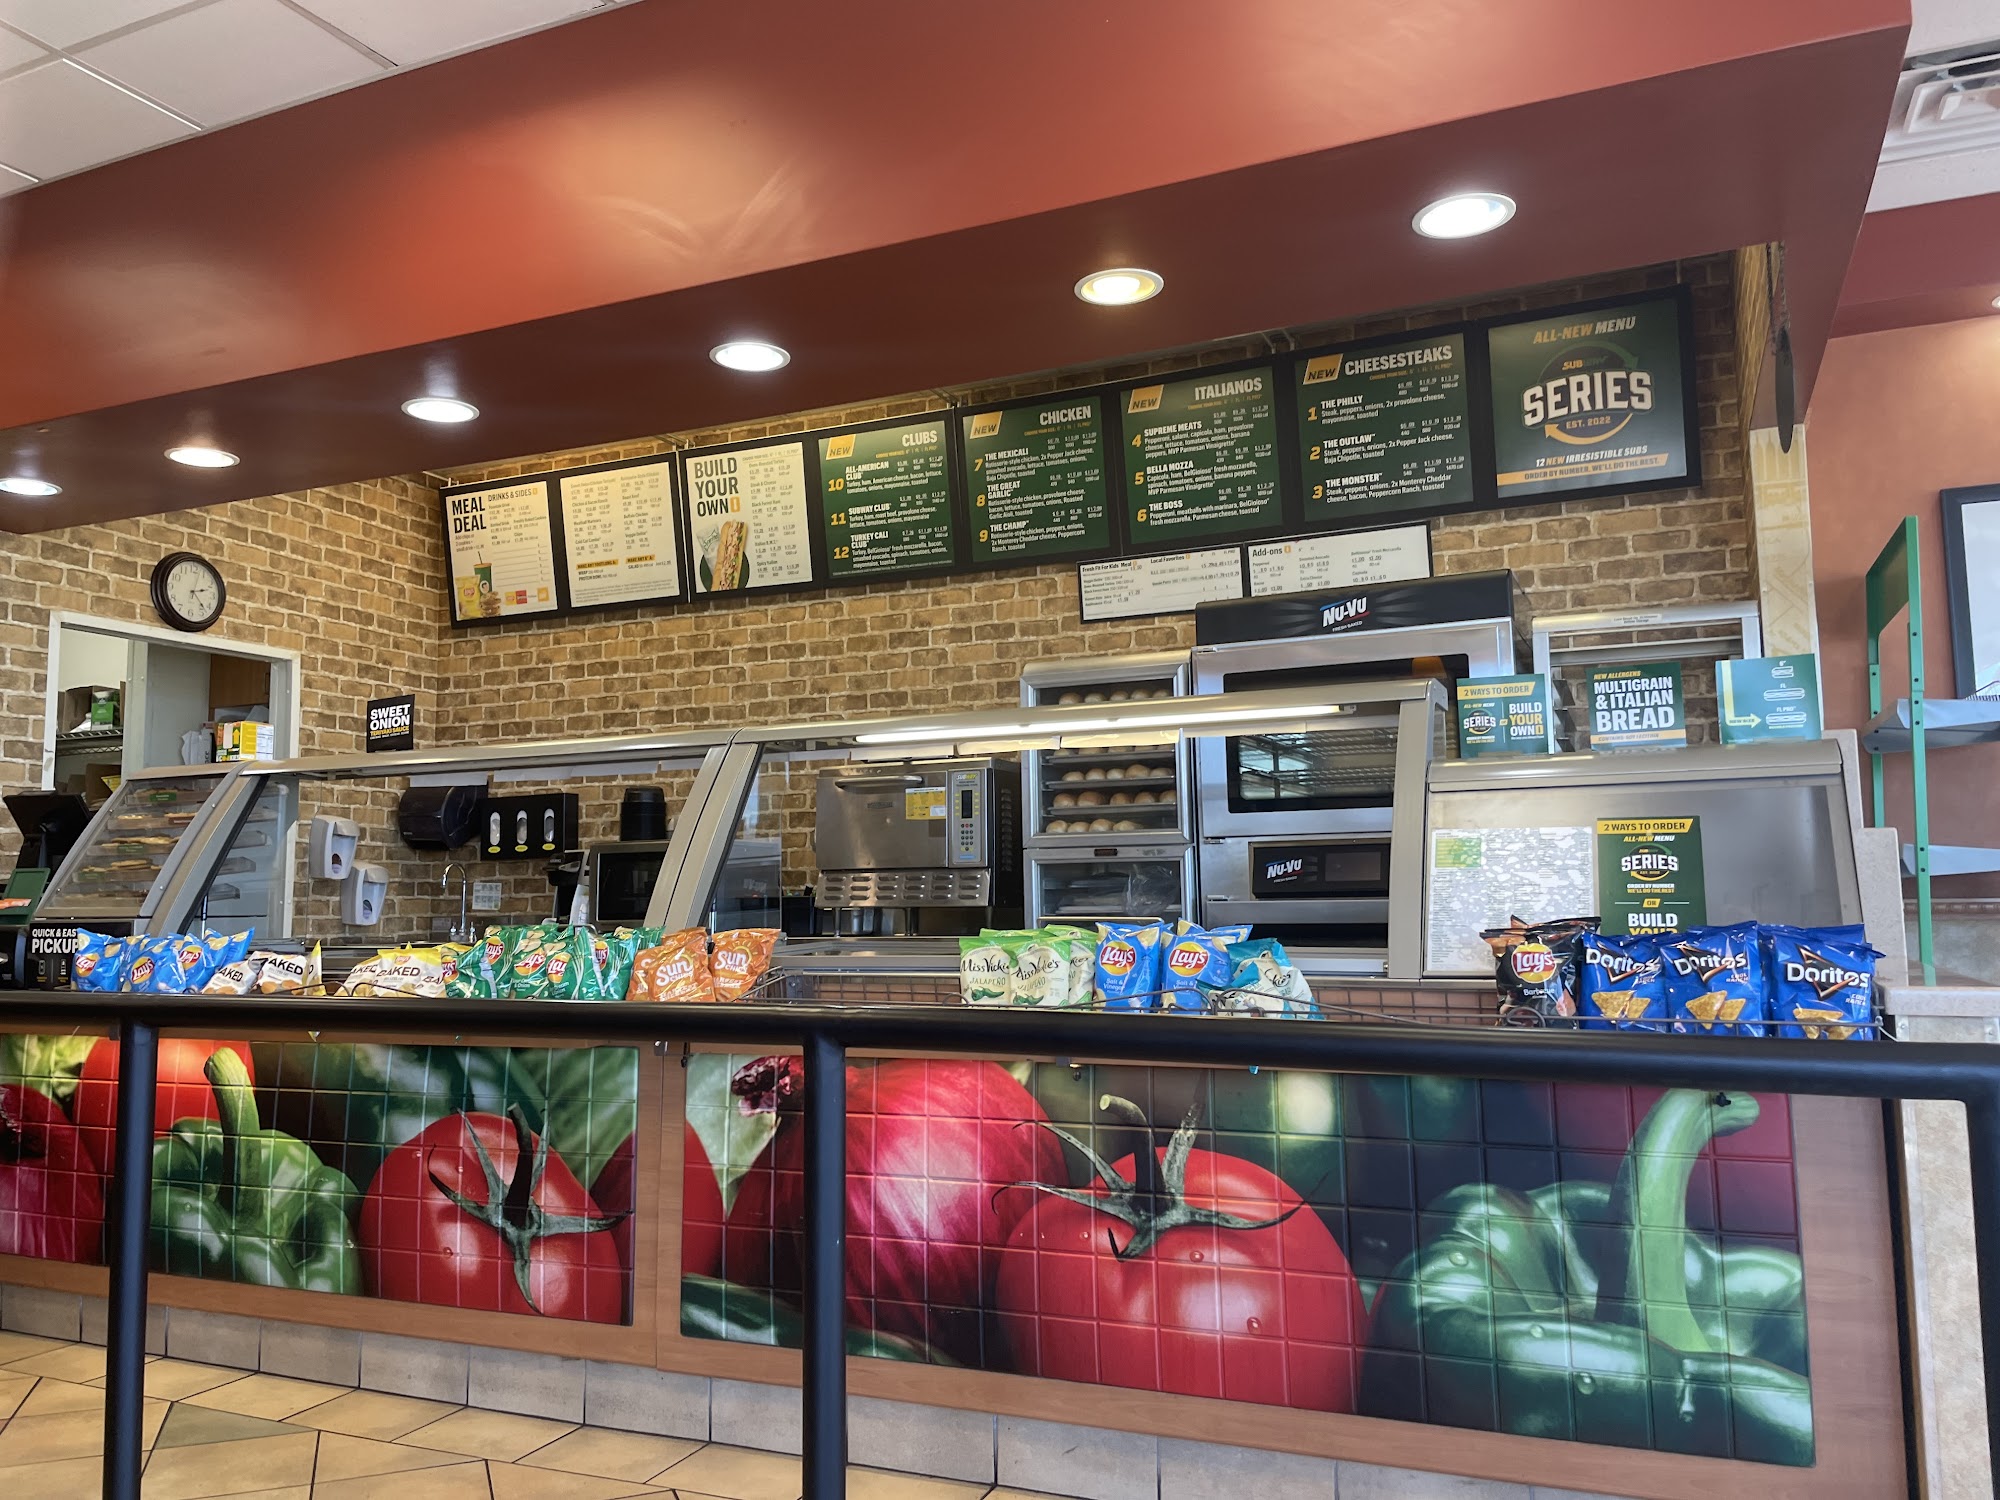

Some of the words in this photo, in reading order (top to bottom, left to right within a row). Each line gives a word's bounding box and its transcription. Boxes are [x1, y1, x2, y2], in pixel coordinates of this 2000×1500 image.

[1533, 322, 1593, 344] ALL-NEW
[1594, 316, 1636, 334] MENU
[1307, 367, 1335, 380] NEW
[1344, 344, 1452, 376] CHEESESTEAKS
[1131, 397, 1157, 409] NEW
[1194, 377, 1262, 400] ITALIANOS
[1521, 364, 1653, 427] SERIES
[1320, 399, 1336, 409] THE
[1336, 394, 1363, 406] PHILLY
[1386, 400, 1393, 408] 2x
[1394, 395, 1422, 407] provolone
[973, 423, 996, 435] NEW
[1039, 405, 1091, 425] CHICKEN
[1307, 406, 1317, 421] 1
[1356, 410, 1378, 420] toasted
[1143, 424, 1177, 436] SUPREME
[1177, 420, 1202, 431] MEATS
[1565, 419, 1585, 429] EST.
[1587, 415, 1611, 426] 2022
[829, 445, 850, 456] NEW
[901, 429, 937, 447] CLUBS
[1131, 434, 1141, 447] 4
[1323, 439, 1338, 448] THE
[984, 452, 997, 460] THE
[998, 447, 1028, 459] MEXICALI
[1309, 445, 1320, 460] 2
[1536, 458, 1544, 467] 12
[1545, 455, 1565, 466] NEW
[1566, 448, 1622, 463] IRRESISTIBLE
[1623, 445, 1647, 456] SUBS
[693, 456, 737, 479] BUILD
[845, 461, 889, 473] ALL-AMERICAN
[973, 458, 983, 471] 7
[1146, 463, 1168, 474] BELLA
[1168, 460, 1193, 471] MOZZA
[1524, 470, 1547, 480] ORDER
[1548, 469, 1557, 477] BY
[1613, 461, 1624, 469] DO
[1624, 459, 1638, 468] THE
[827, 477, 844, 491] 10
[1134, 471, 1144, 485] 5
[1325, 478, 1340, 488] THE
[694, 475, 739, 499] YOUR
[987, 483, 999, 491] THE
[999, 480, 1020, 490] GREAT
[1311, 484, 1323, 499] 3
[487, 491, 509, 502] DRINKS
[515, 488, 531, 497] SIDES
[975, 494, 985, 507] 8
[451, 495, 485, 515] MEAL
[696, 497, 728, 517] OWN
[848, 505, 873, 515] SUBWAY
[1149, 502, 1163, 511] THE
[1163, 499, 1183, 509] BOSS
[830, 512, 846, 525] 11
[1136, 508, 1147, 522] 6
[453, 513, 486, 533] DEAL
[989, 523, 1002, 532] THE
[850, 532, 874, 541] TURKEY
[874, 531, 888, 539] CALI
[978, 529, 988, 542] 9
[833, 546, 849, 559] 12
[1251, 546, 1282, 557] Add-ons
[1503, 685, 1529, 693] ORDER
[1594, 676, 1673, 694] MULTIGRAIN
[1595, 695, 1608, 710] &
[1610, 690, 1674, 708] ITALIAN
[370, 704, 411, 720] SWEET
[1509, 702, 1542, 714] BUILD
[370, 714, 410, 730] ONION
[1464, 716, 1496, 729] SERIES
[1509, 713, 1542, 726] YOUR
[1596, 706, 1674, 732] BREAD
[1510, 726, 1535, 736] OWN
[1611, 823, 1636, 831] WAYS
[1653, 822, 1685, 830] ORDER
[1621, 854, 1679, 872] SERIES
[1627, 913, 1678, 927] BUILD
[32, 928, 55, 937] QUICK
[56, 929, 61, 937] &
[62, 928, 77, 937] EAS
[32, 938, 79, 954] PICKUP
[715, 951, 746, 970] Sun
[1102, 947, 1134, 968] Lay's
[1171, 950, 1207, 968] Lay's
[1517, 952, 1554, 973] Lay's
[1674, 952, 1746, 976] Doritos
[656, 960, 692, 986] Sun
[1787, 962, 1871, 988] Doritos
